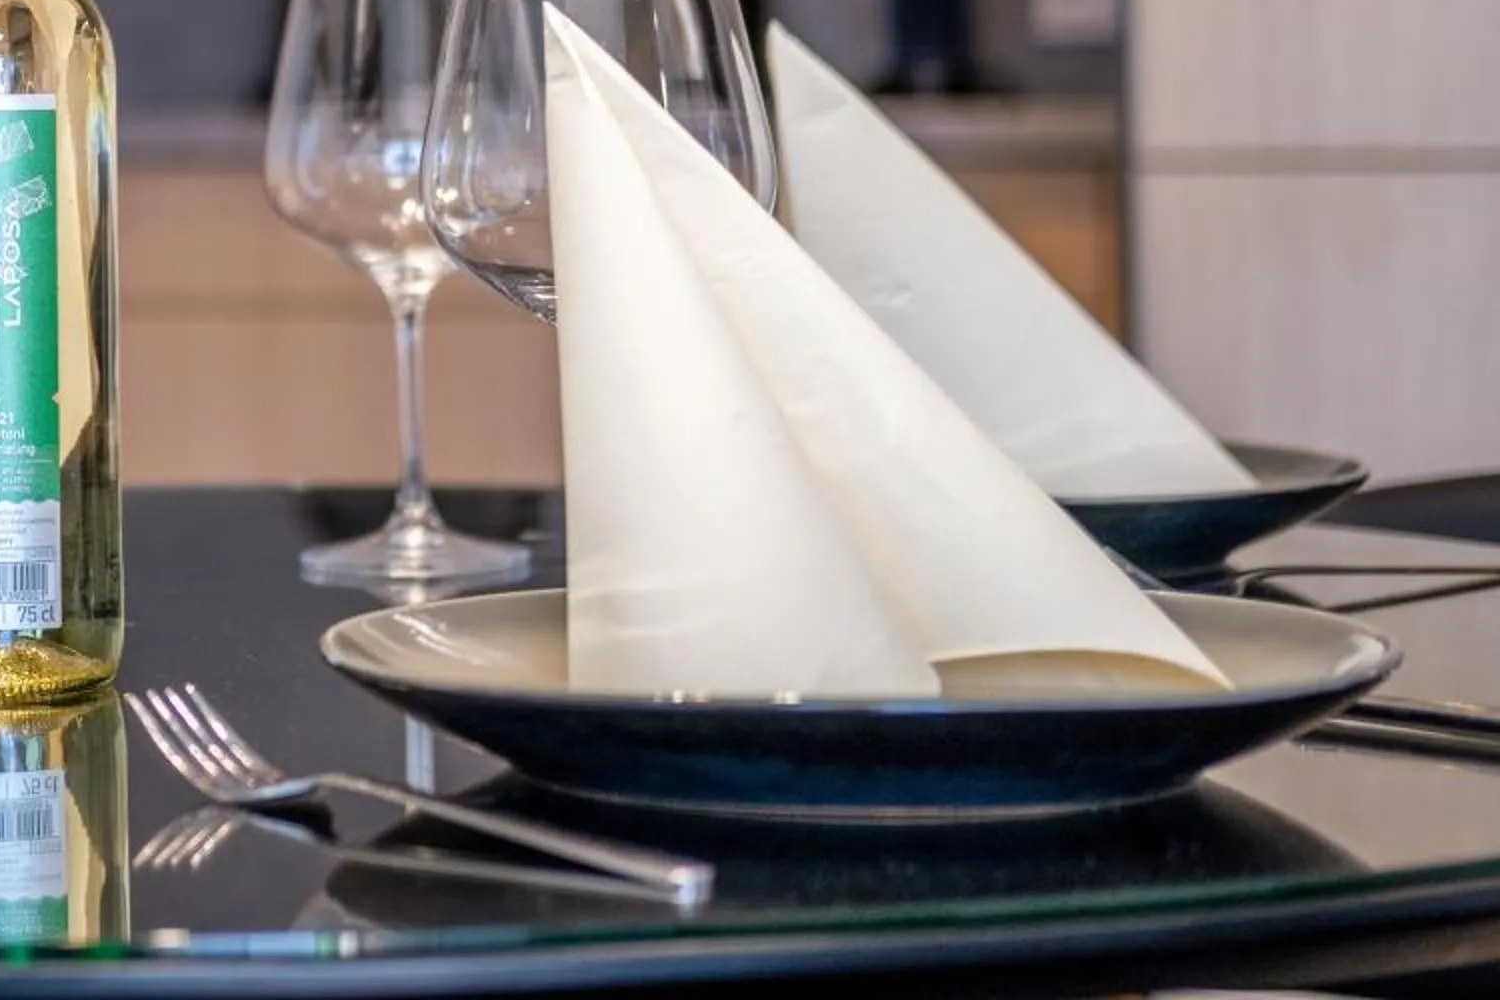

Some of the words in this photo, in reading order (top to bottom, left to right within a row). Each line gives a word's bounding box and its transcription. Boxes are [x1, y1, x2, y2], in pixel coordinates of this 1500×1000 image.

[3, 198, 21, 327] LAPOSA
[17, 605, 37, 623] 75
[41, 604, 56, 623] cl
